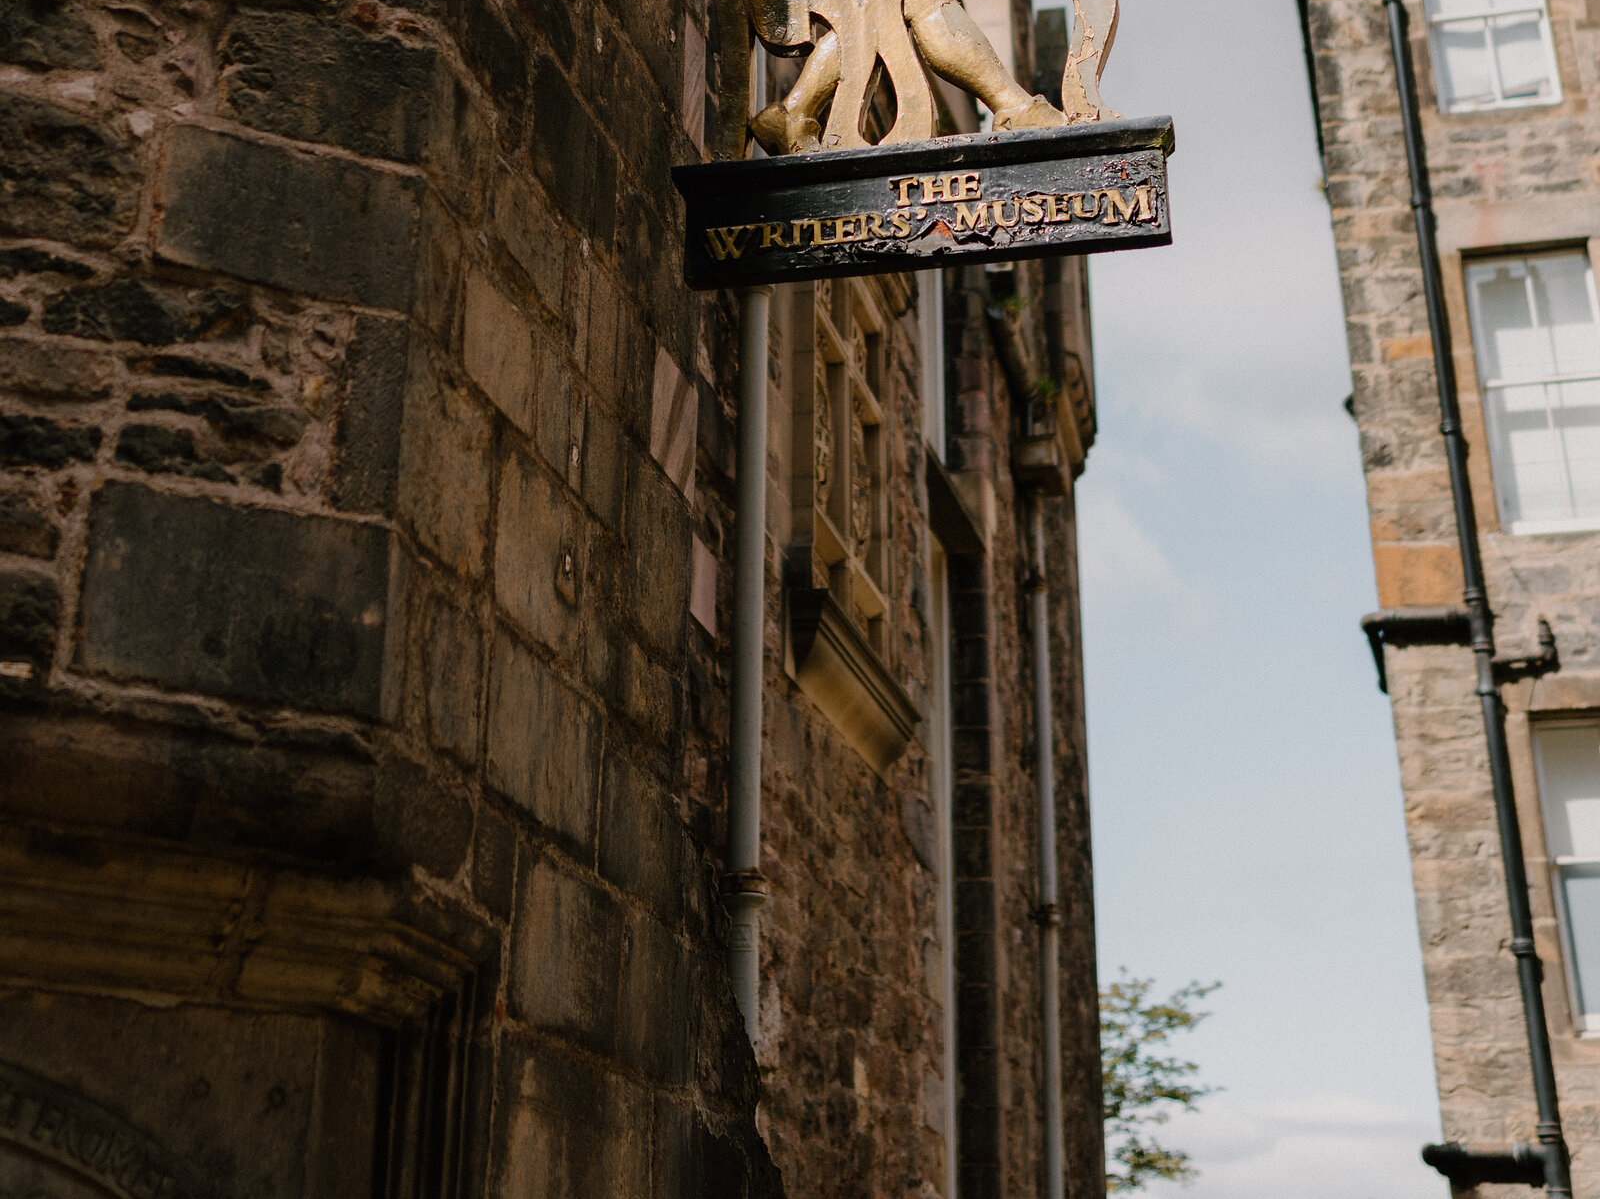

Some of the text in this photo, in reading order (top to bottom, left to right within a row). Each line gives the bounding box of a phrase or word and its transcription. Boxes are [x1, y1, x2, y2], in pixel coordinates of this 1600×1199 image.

[889, 172, 981, 207] THE
[704, 186, 1157, 261] WRITERS’ MUSEUM
